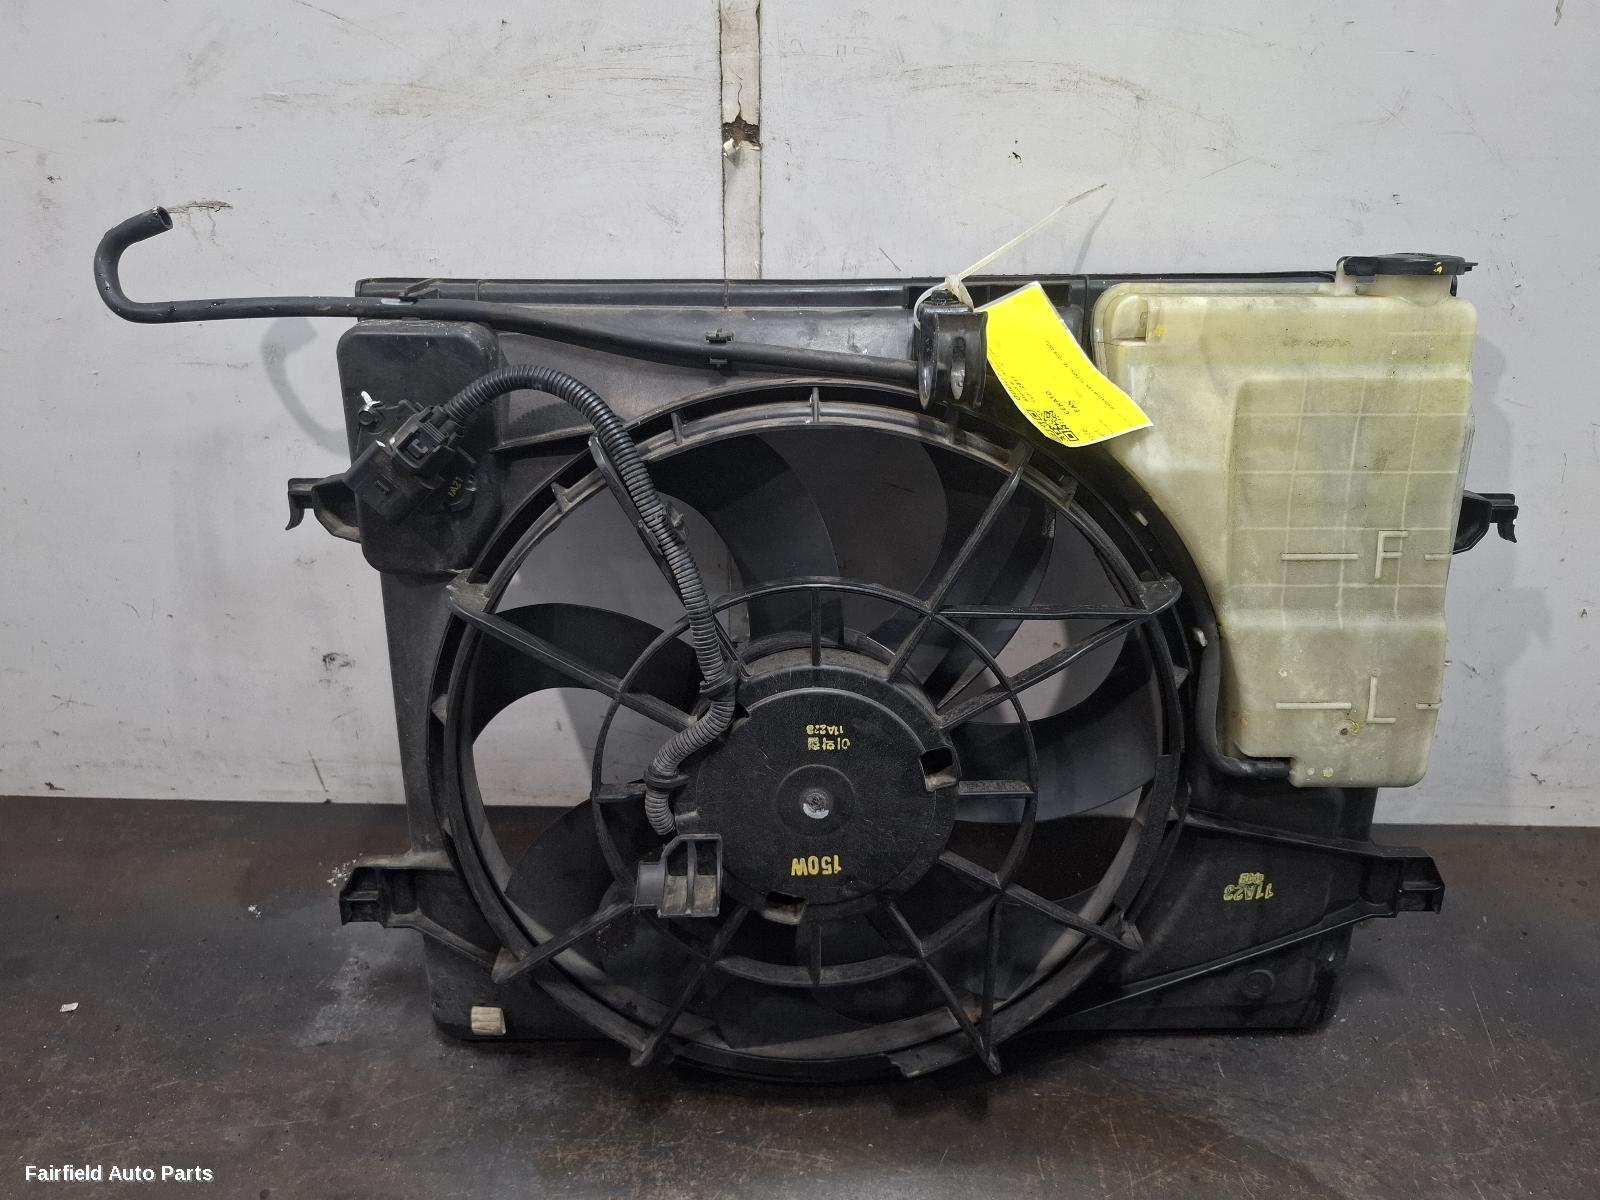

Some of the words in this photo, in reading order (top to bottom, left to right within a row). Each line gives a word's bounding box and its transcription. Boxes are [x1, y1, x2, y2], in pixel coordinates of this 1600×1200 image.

[1045, 391, 1070, 415] CERATO
[1375, 530, 1408, 579] F
[1366, 676, 1396, 724] L
[791, 854, 842, 876] 150W
